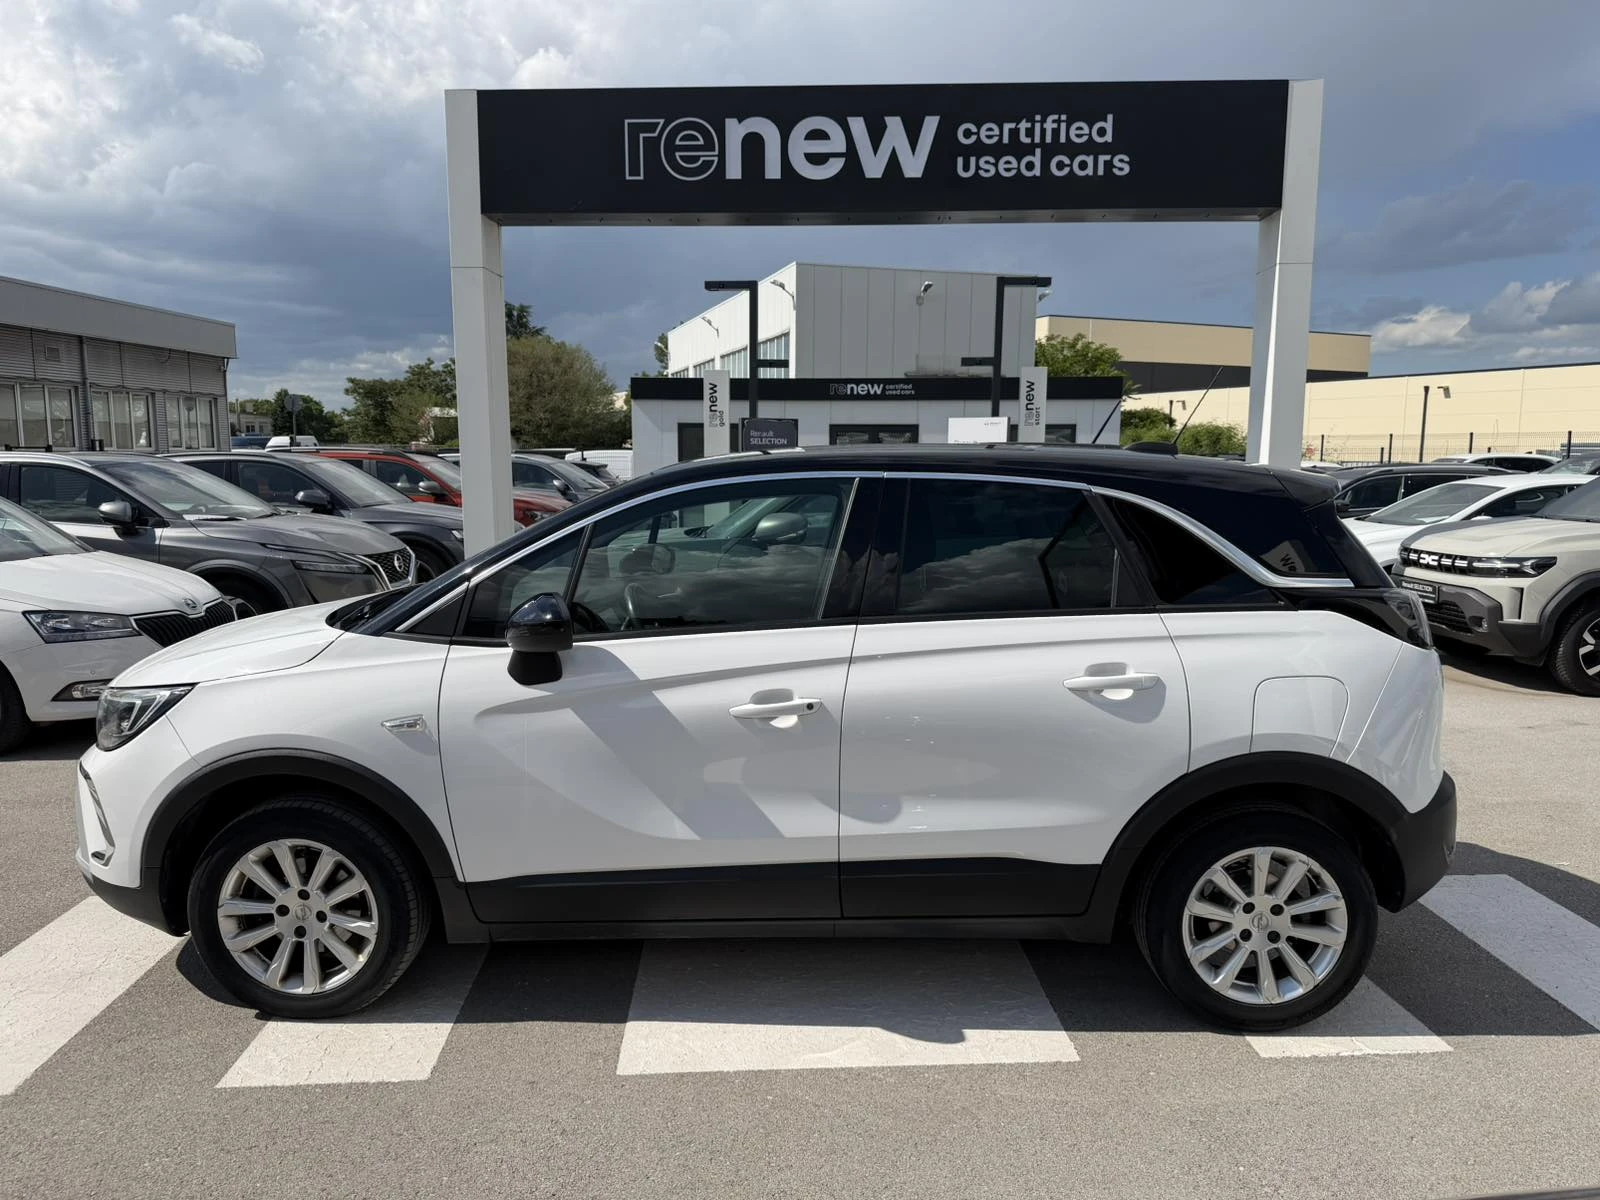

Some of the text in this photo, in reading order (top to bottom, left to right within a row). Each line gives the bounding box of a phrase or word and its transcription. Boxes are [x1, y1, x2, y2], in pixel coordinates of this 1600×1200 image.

[957, 113, 1114, 145] certified
[624, 115, 941, 181] renew
[956, 148, 1131, 178] used cars
[708, 382, 718, 428] renew
[829, 383, 884, 396] renew
[1023, 380, 1035, 427] renew
[718, 410, 726, 428] gold
